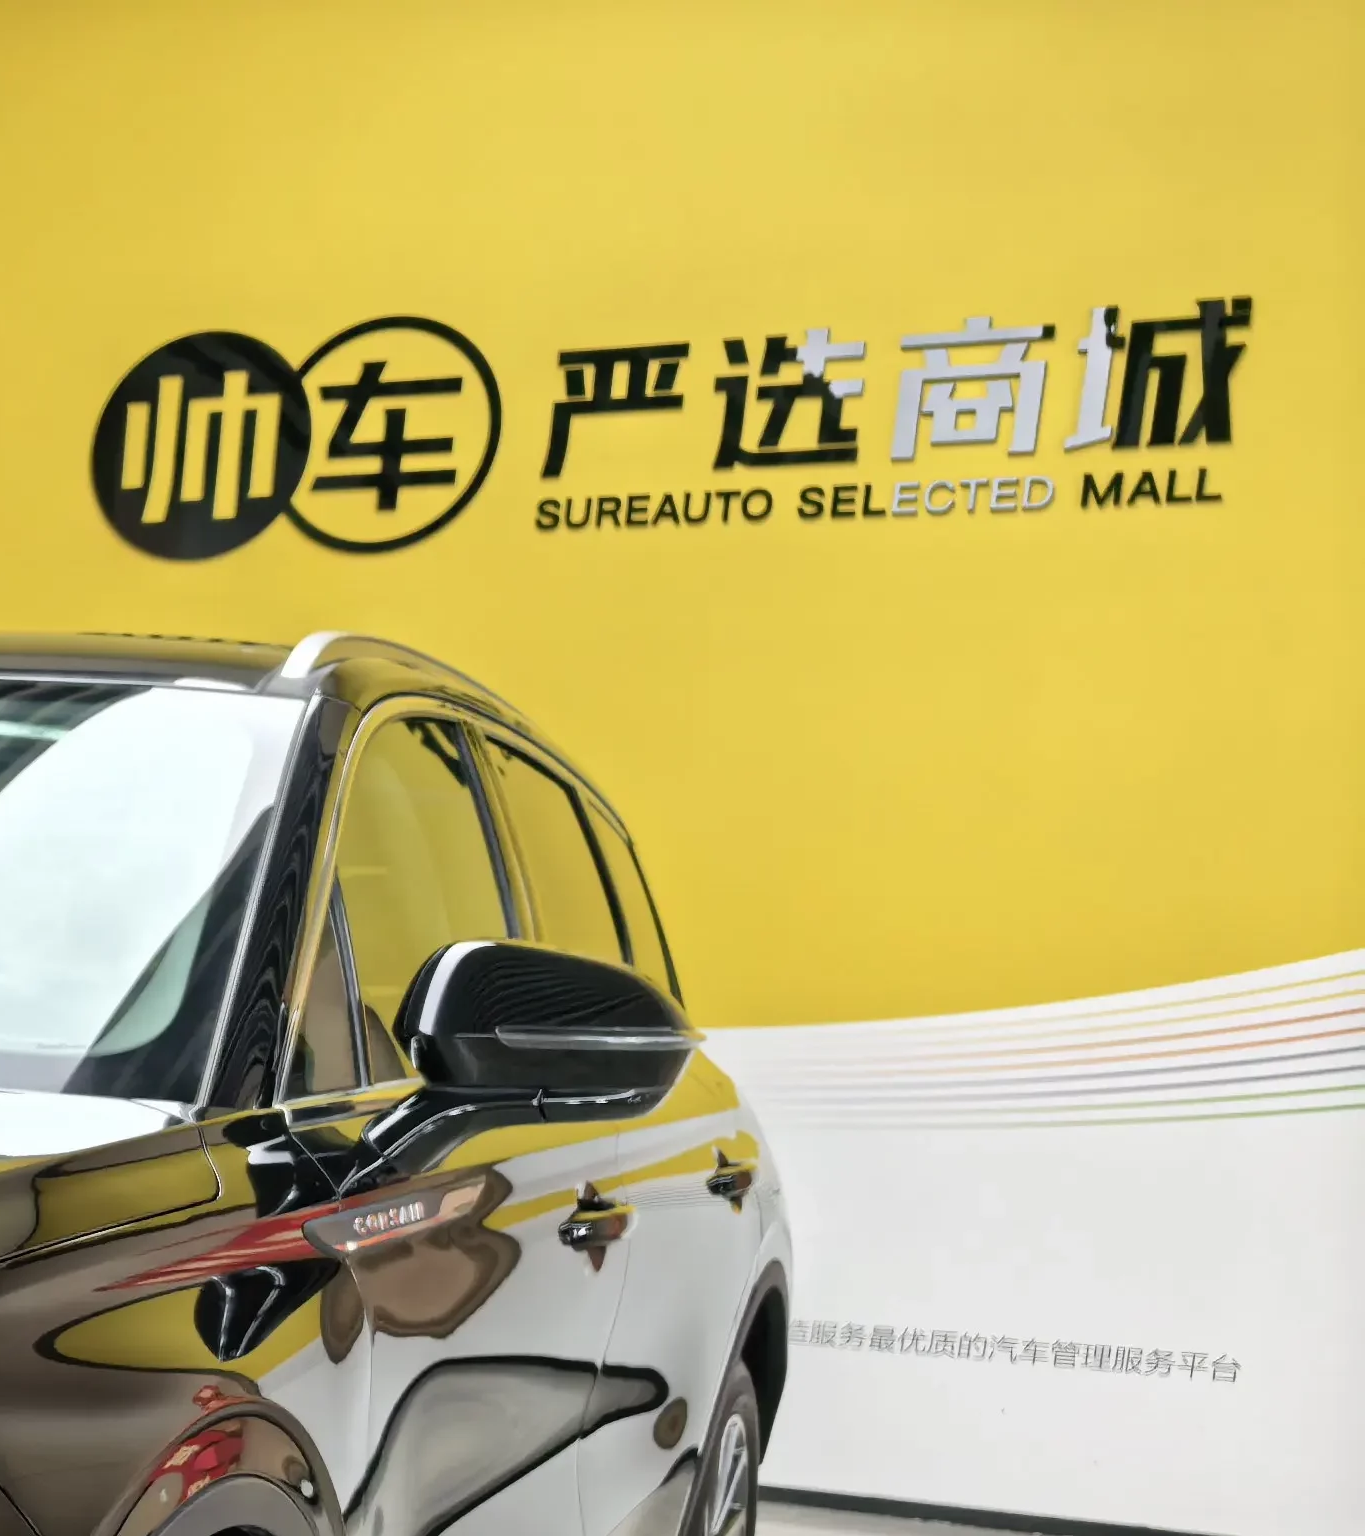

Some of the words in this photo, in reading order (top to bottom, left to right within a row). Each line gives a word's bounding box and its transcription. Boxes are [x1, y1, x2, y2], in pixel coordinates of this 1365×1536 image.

[541, 296, 1253, 480] 严选商城
[535, 486, 775, 534] SUREAUTO
[797, 474, 1056, 523] SELECTED
[1080, 467, 1224, 512] MALL
